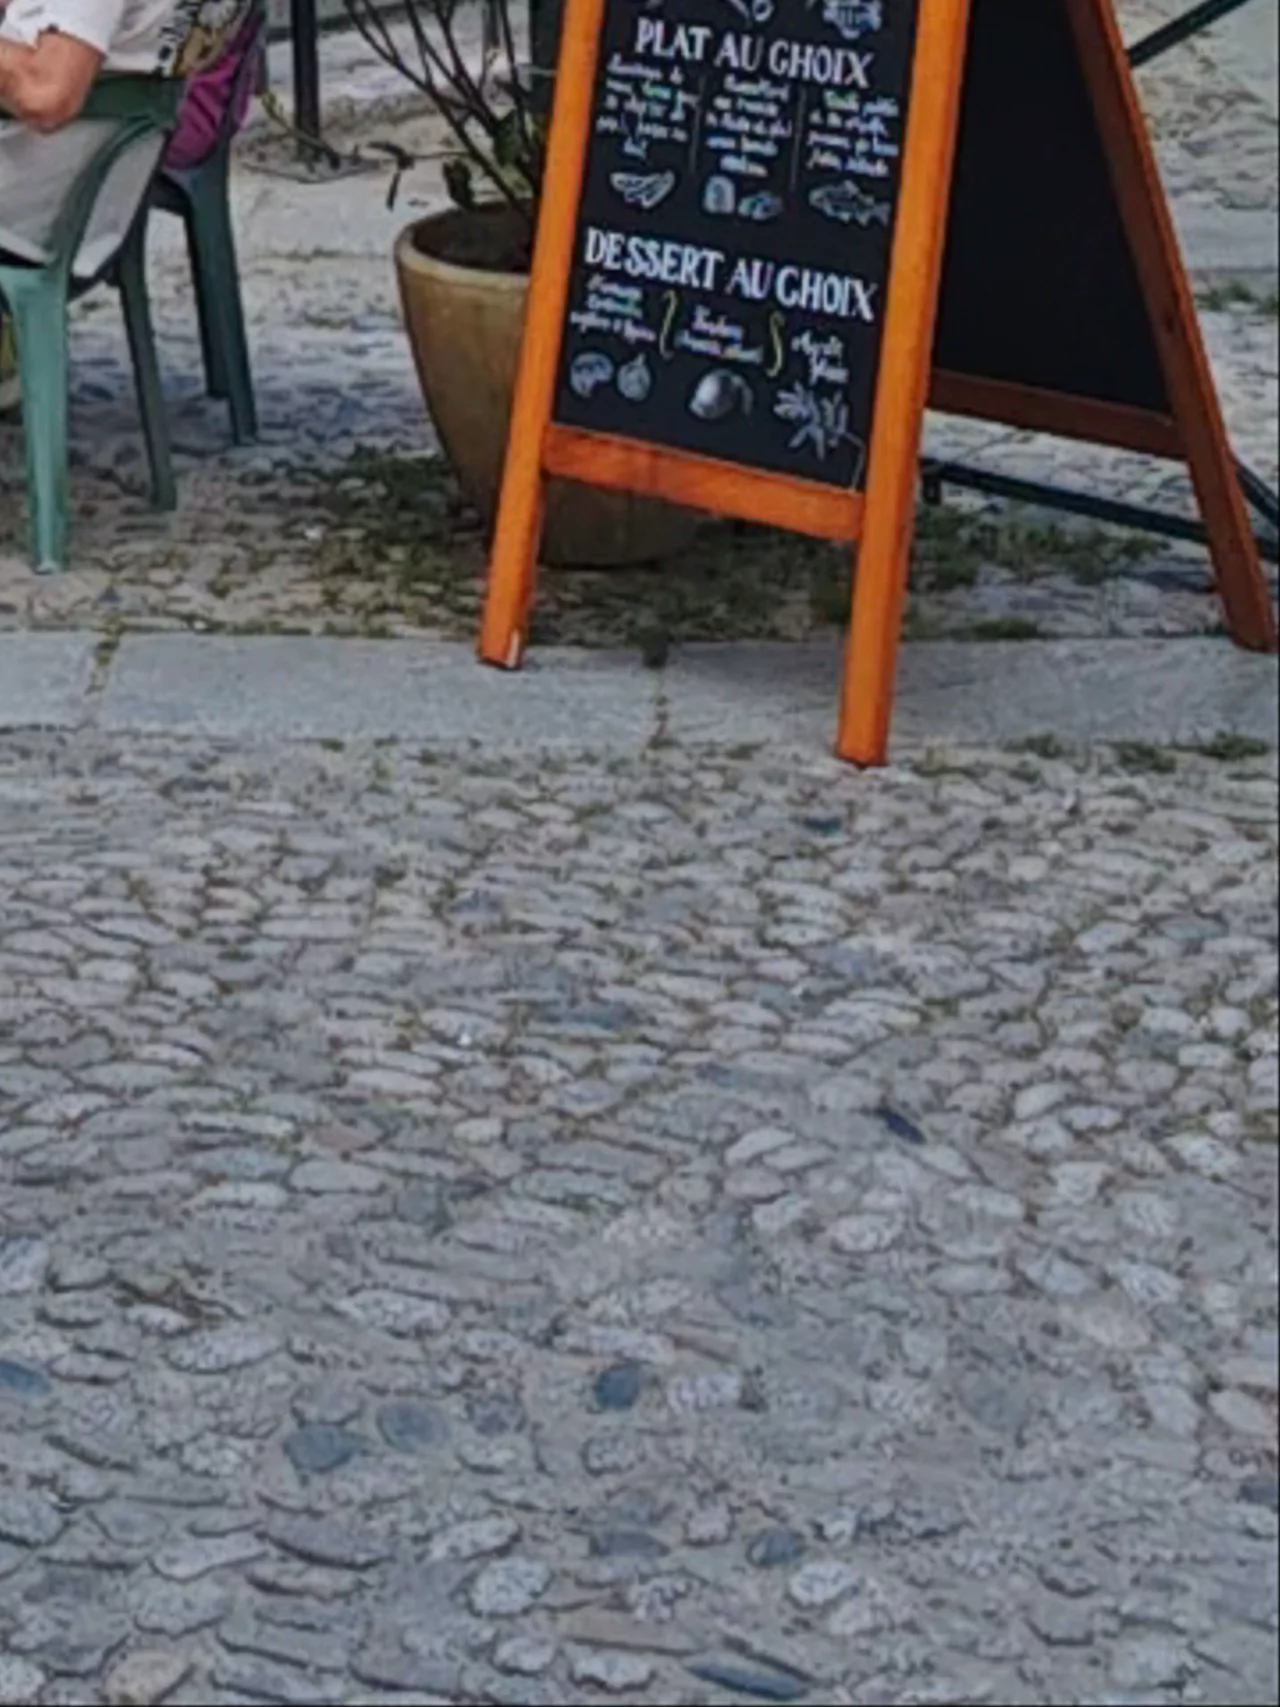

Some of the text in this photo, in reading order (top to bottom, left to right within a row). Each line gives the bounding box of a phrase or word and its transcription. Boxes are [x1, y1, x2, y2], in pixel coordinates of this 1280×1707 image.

[634, 15, 875, 89] PLAT AU CHOIX
[584, 226, 879, 322] DESSERT AU CHOIX
